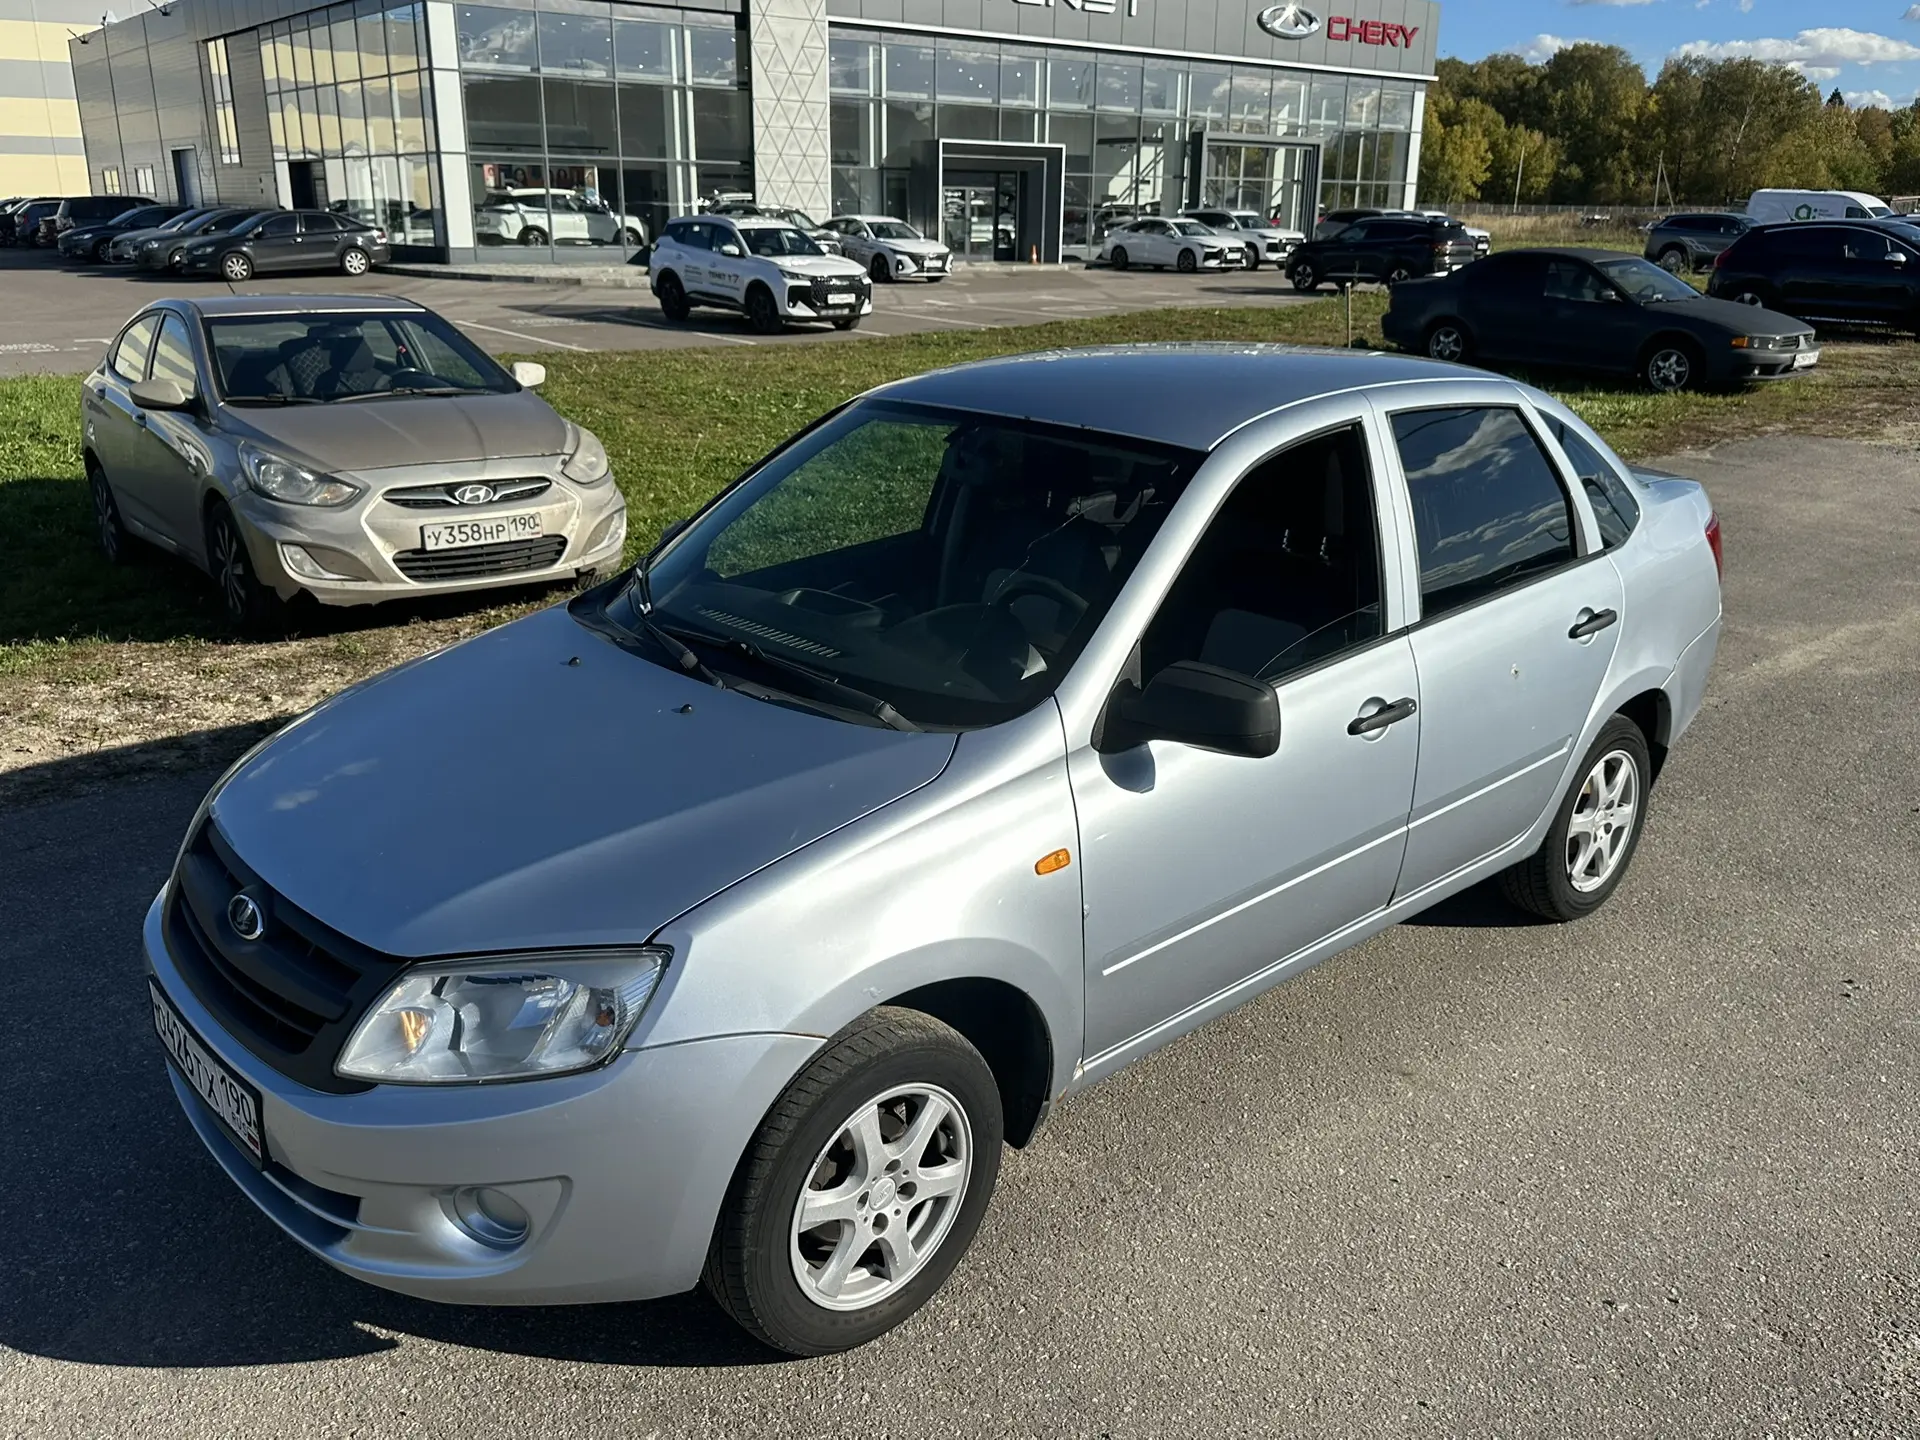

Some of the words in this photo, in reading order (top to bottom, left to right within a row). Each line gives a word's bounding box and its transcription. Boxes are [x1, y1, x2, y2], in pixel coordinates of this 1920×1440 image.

[1327, 16, 1420, 49] CHERY
[511, 515, 536, 532] 190
[220, 1074, 253, 1125] 190
